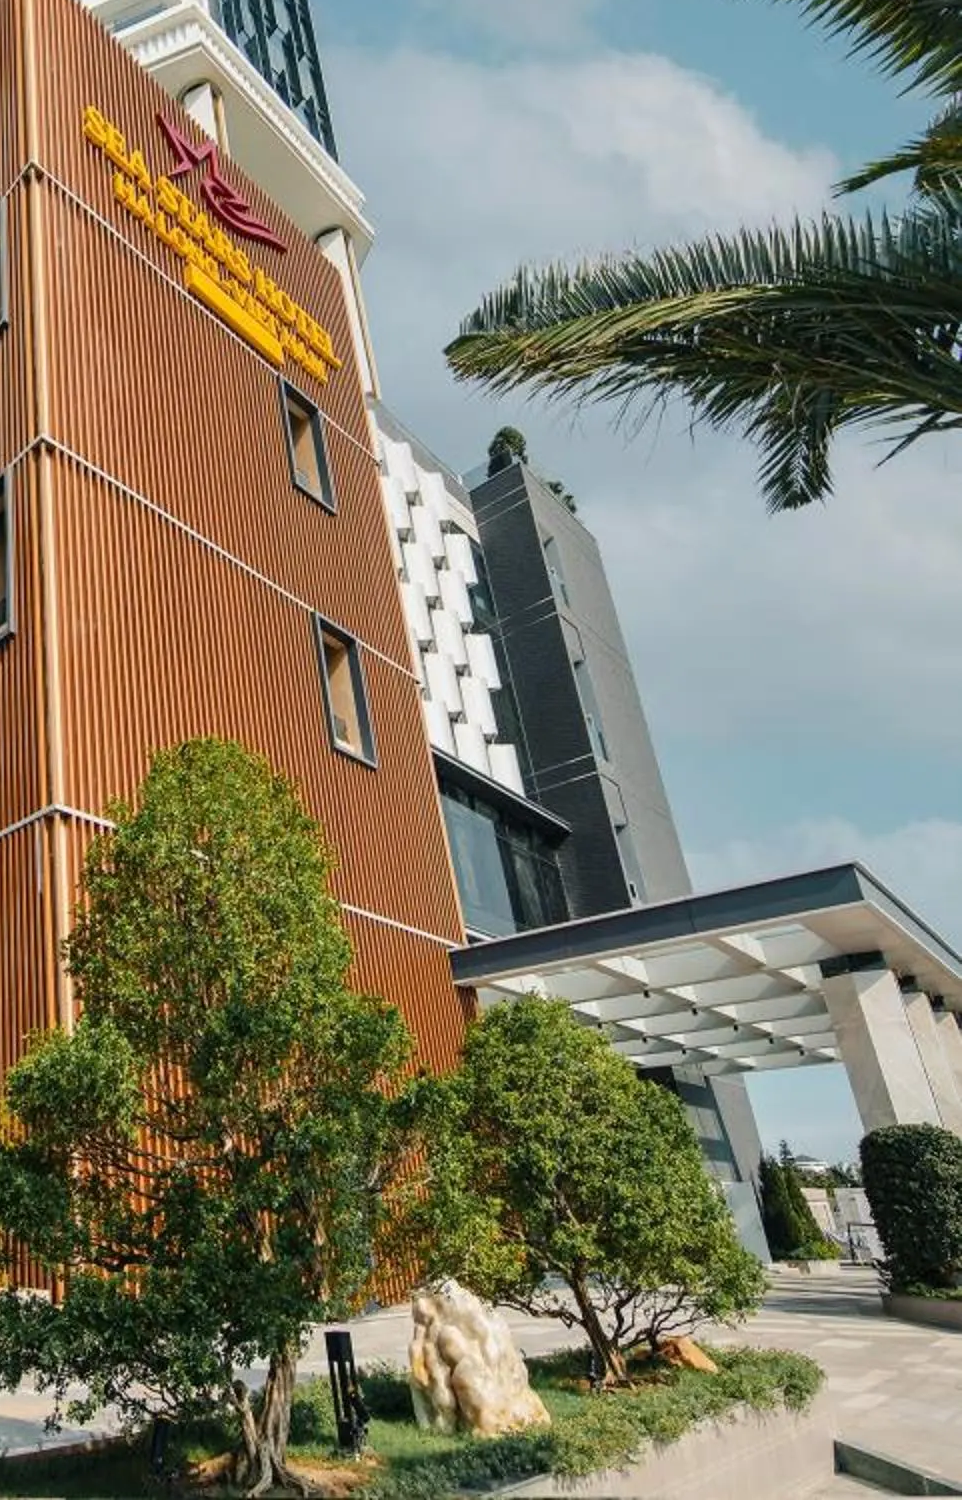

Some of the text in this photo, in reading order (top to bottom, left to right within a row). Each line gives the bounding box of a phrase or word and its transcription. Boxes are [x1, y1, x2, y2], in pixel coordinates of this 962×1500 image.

[83, 106, 343, 369] SEA STARS HOTEL
[112, 171, 153, 229] HA
[154, 211, 219, 283] LONG
